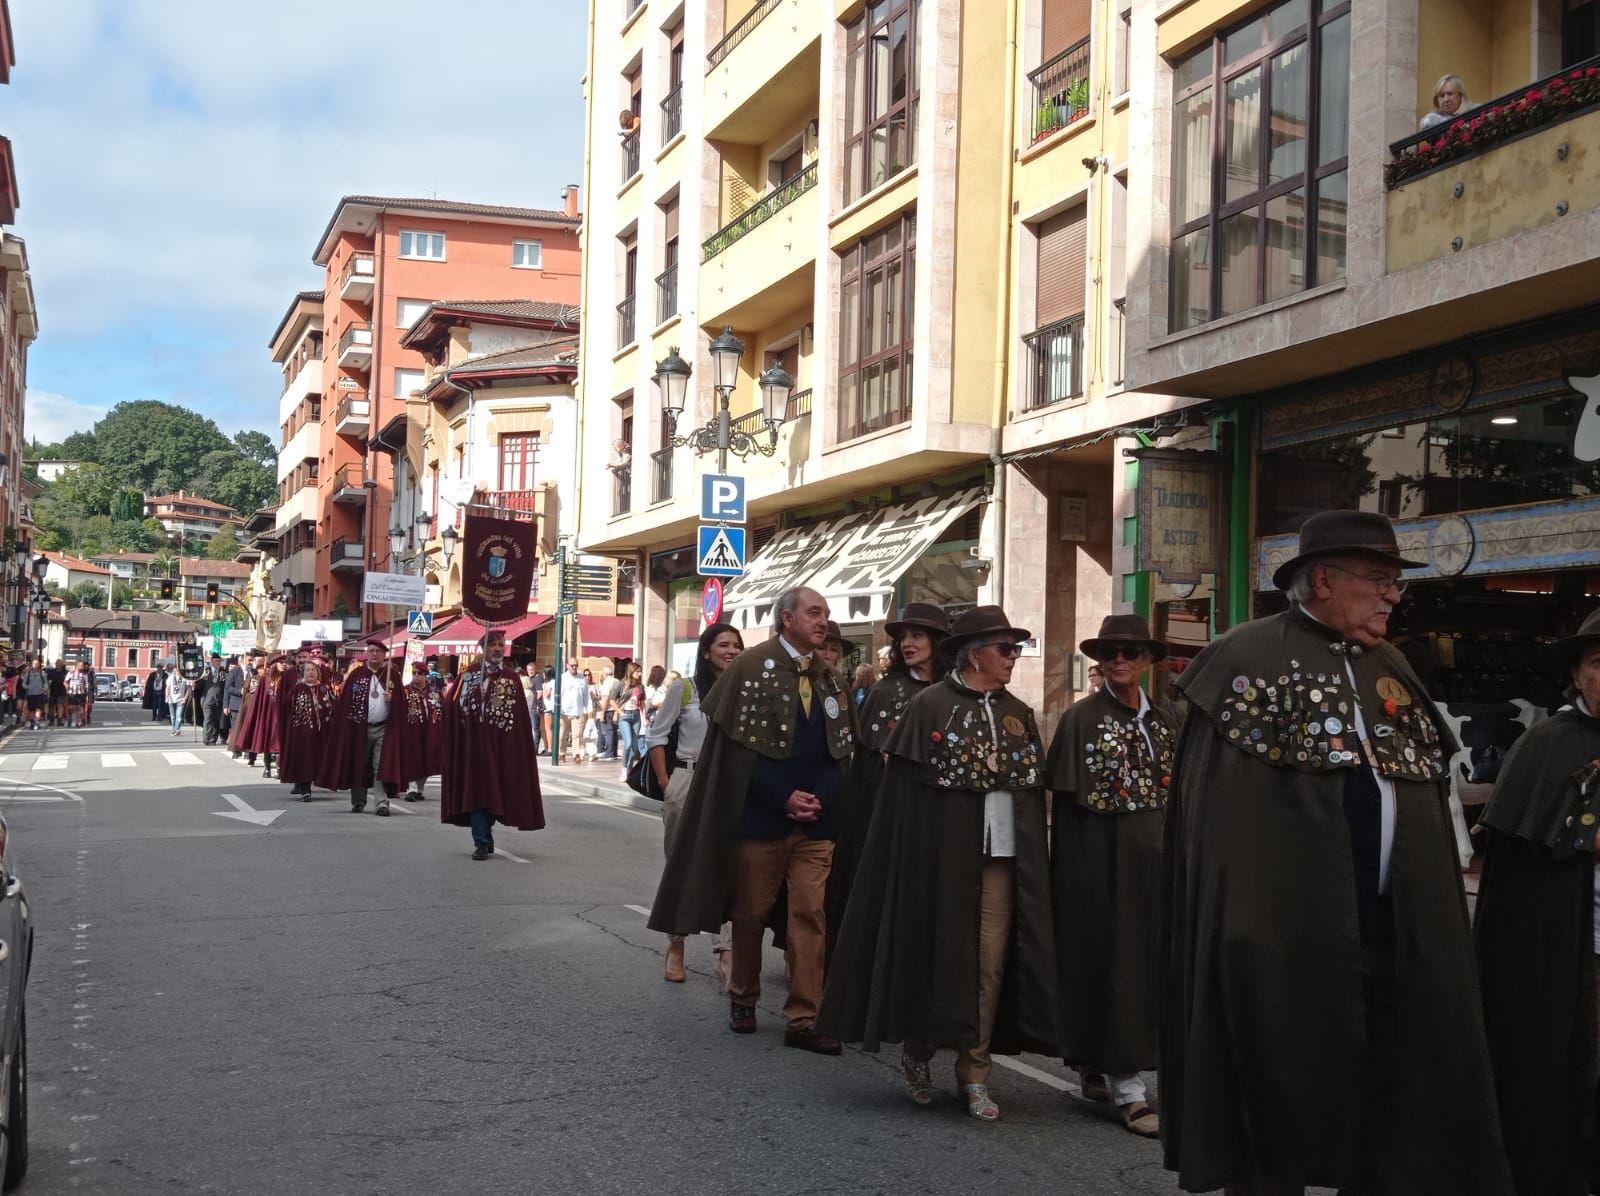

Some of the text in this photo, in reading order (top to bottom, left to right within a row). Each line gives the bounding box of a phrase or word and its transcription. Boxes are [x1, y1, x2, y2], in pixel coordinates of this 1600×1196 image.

[712, 480, 737, 514] P
[438, 645, 483, 654] EL BARA
